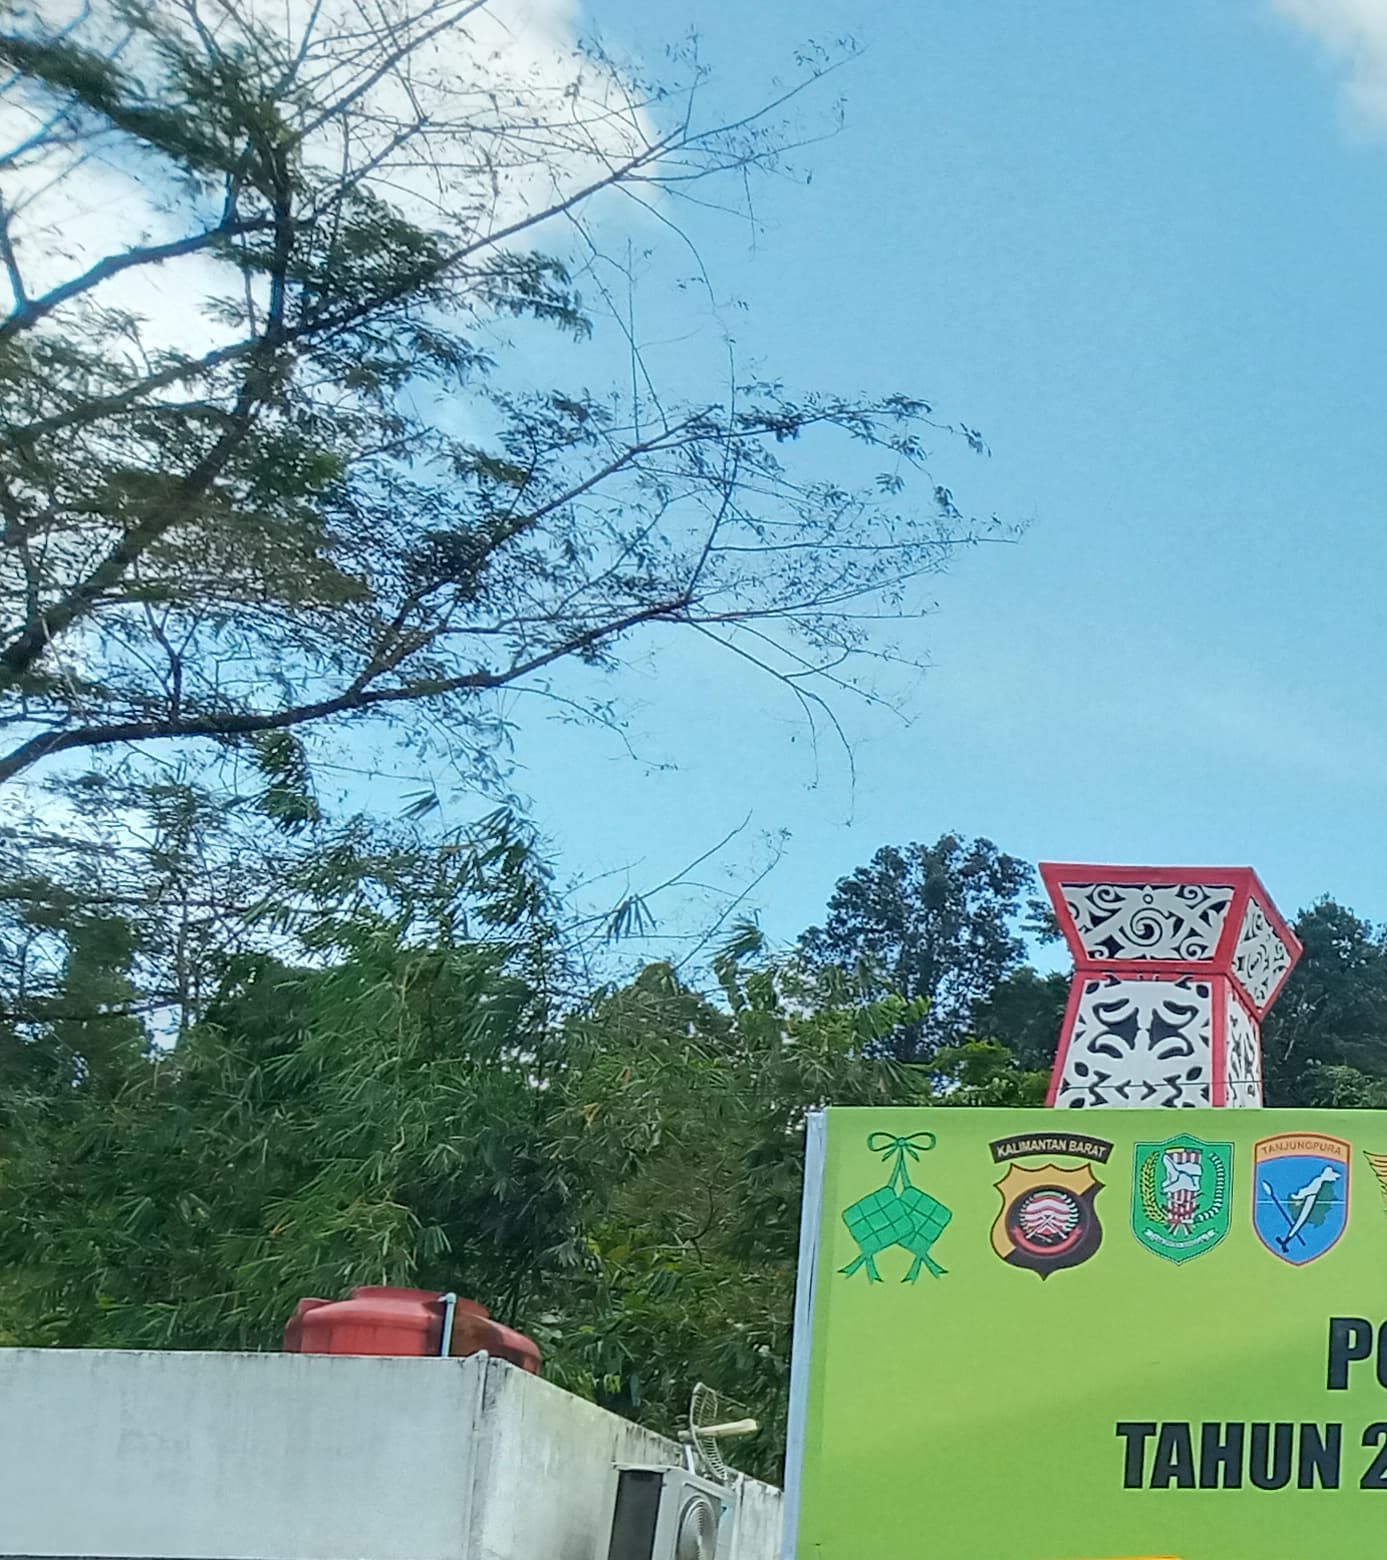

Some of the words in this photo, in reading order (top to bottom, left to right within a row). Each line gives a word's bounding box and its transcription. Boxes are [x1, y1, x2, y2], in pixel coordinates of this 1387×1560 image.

[997, 1139, 1066, 1157] KALIMANTAN
[1069, 1141, 1106, 1157] BARAT
[1260, 1142, 1342, 1156] TANJUNGPURA
[1116, 1421, 1342, 1491] TAHUN
